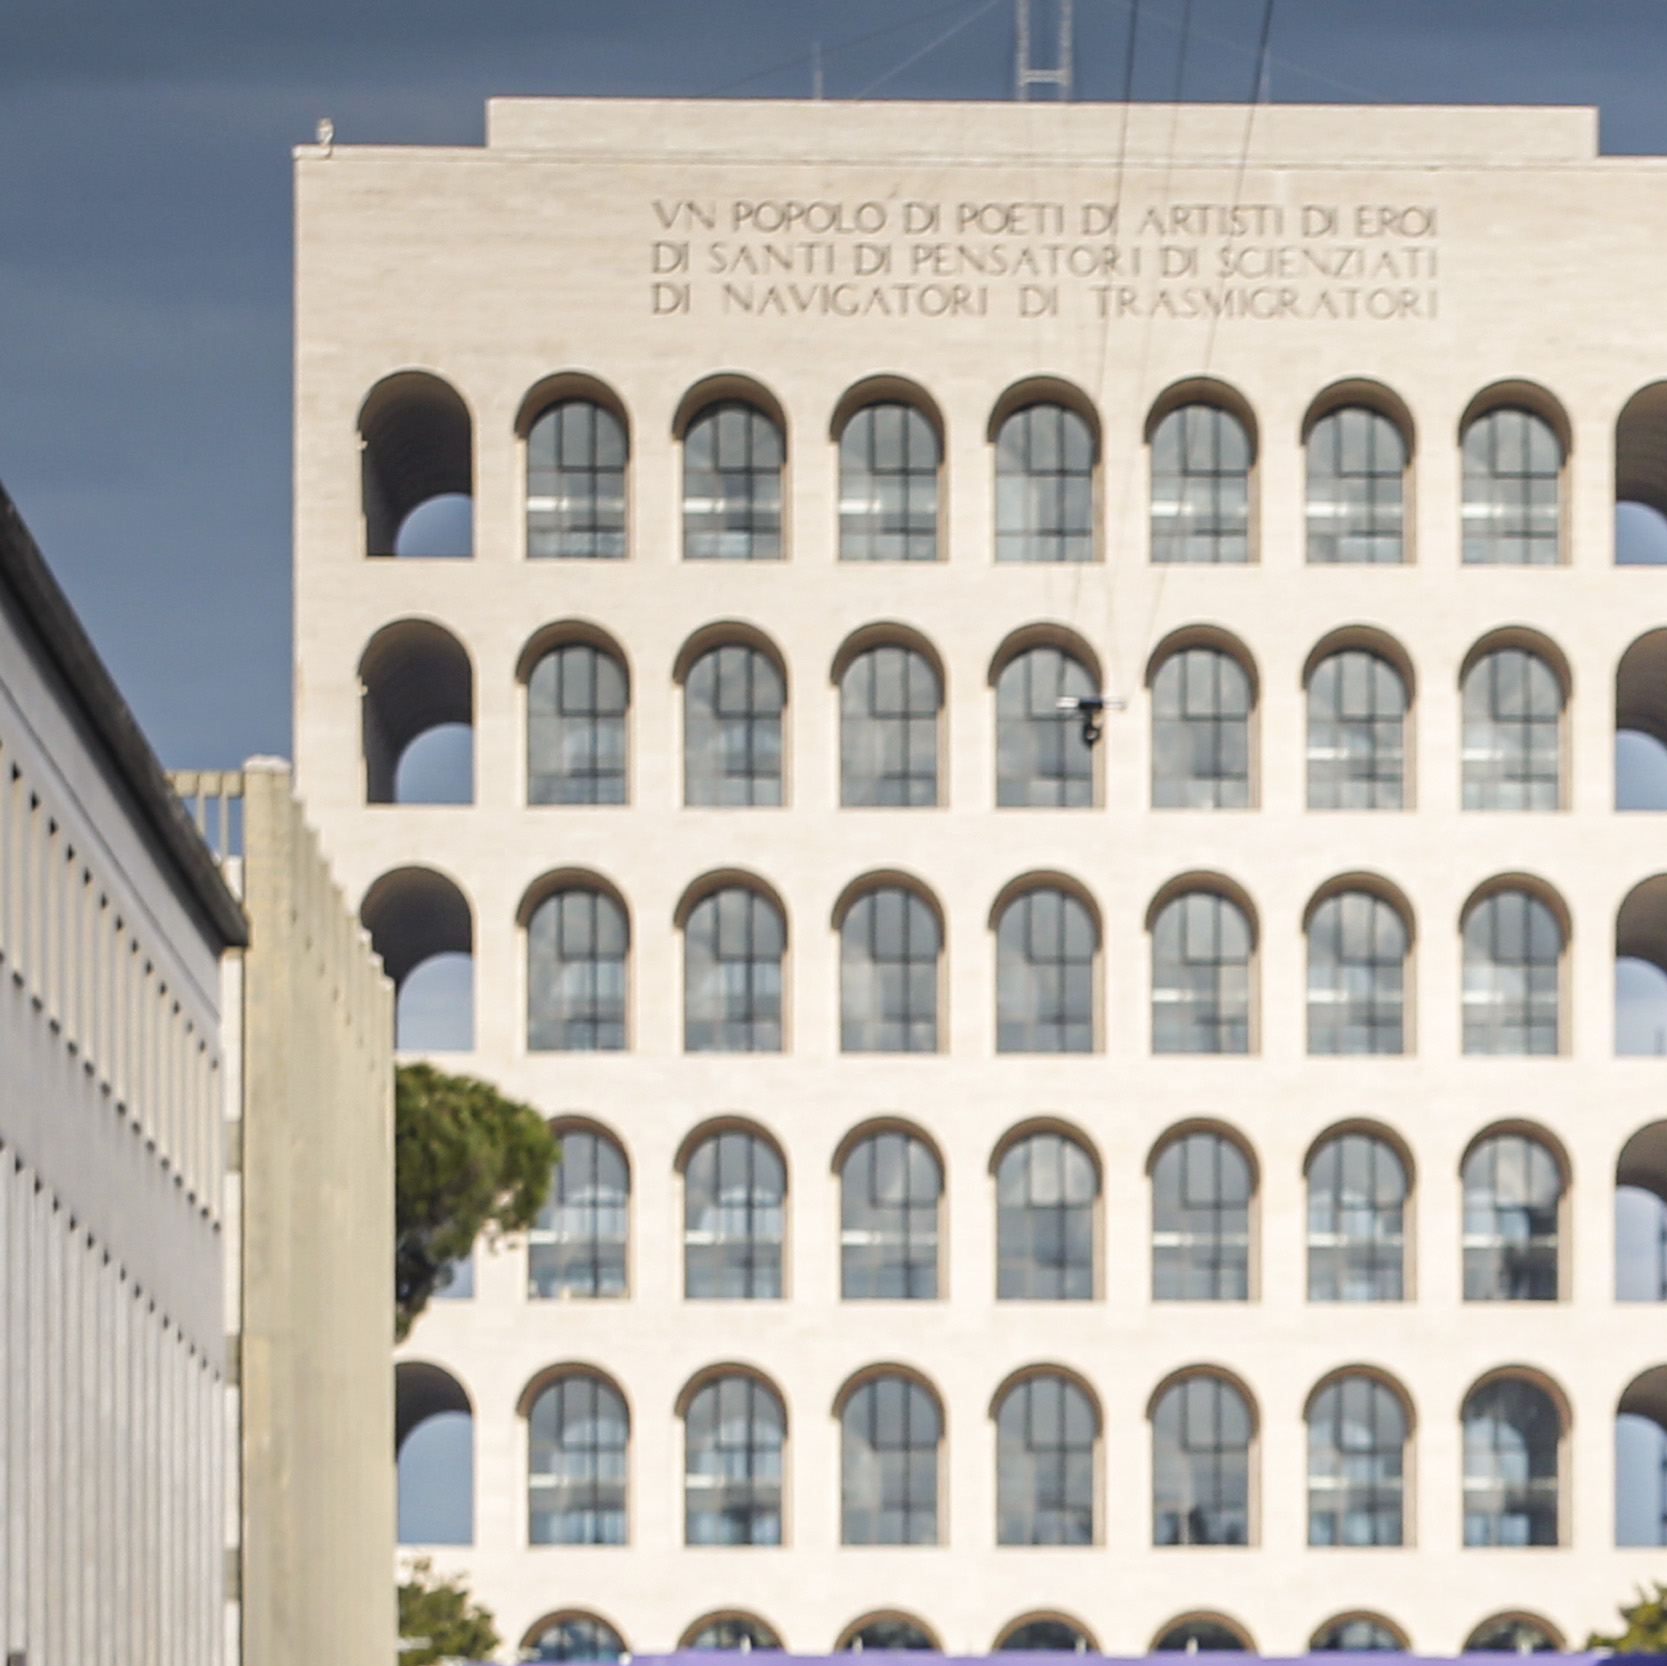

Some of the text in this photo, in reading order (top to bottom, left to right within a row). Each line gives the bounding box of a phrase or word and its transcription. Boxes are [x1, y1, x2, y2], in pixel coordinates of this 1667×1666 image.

[651, 202, 1438, 237] VN POPOLO DI POETI DI ARTISTI DI EROI
[651, 241, 1438, 279] DI SANTI DI PENSATORI DI SCIENZIATI
[651, 282, 1438, 320] DI NAVIGATORI DI TRASMIGRATORI
